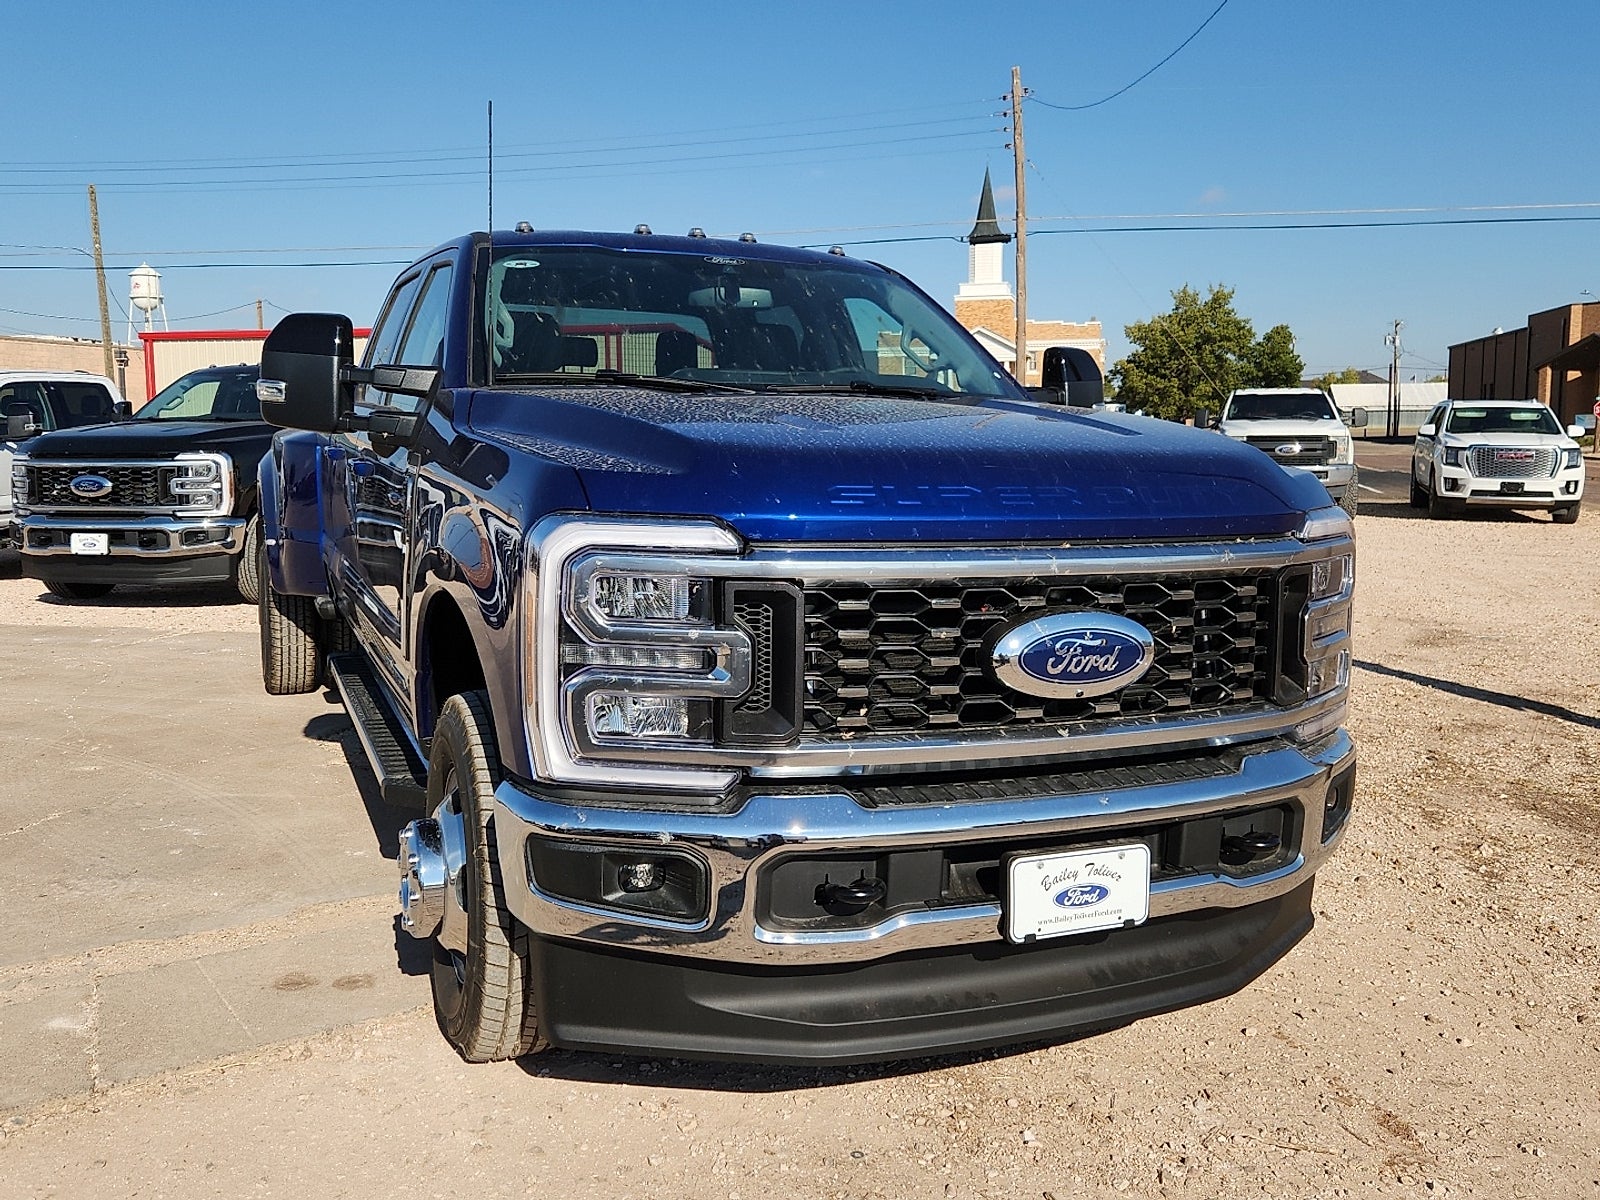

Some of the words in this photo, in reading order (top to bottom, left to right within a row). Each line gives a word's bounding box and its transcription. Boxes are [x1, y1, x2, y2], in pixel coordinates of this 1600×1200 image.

[711, 256, 738, 264] Ford
[827, 484, 1083, 506] SUPER
[1046, 637, 1121, 675] Ford
[1041, 868, 1079, 892] Bailey
[1084, 862, 1122, 882] Toliver
[1063, 886, 1101, 906] Ford
